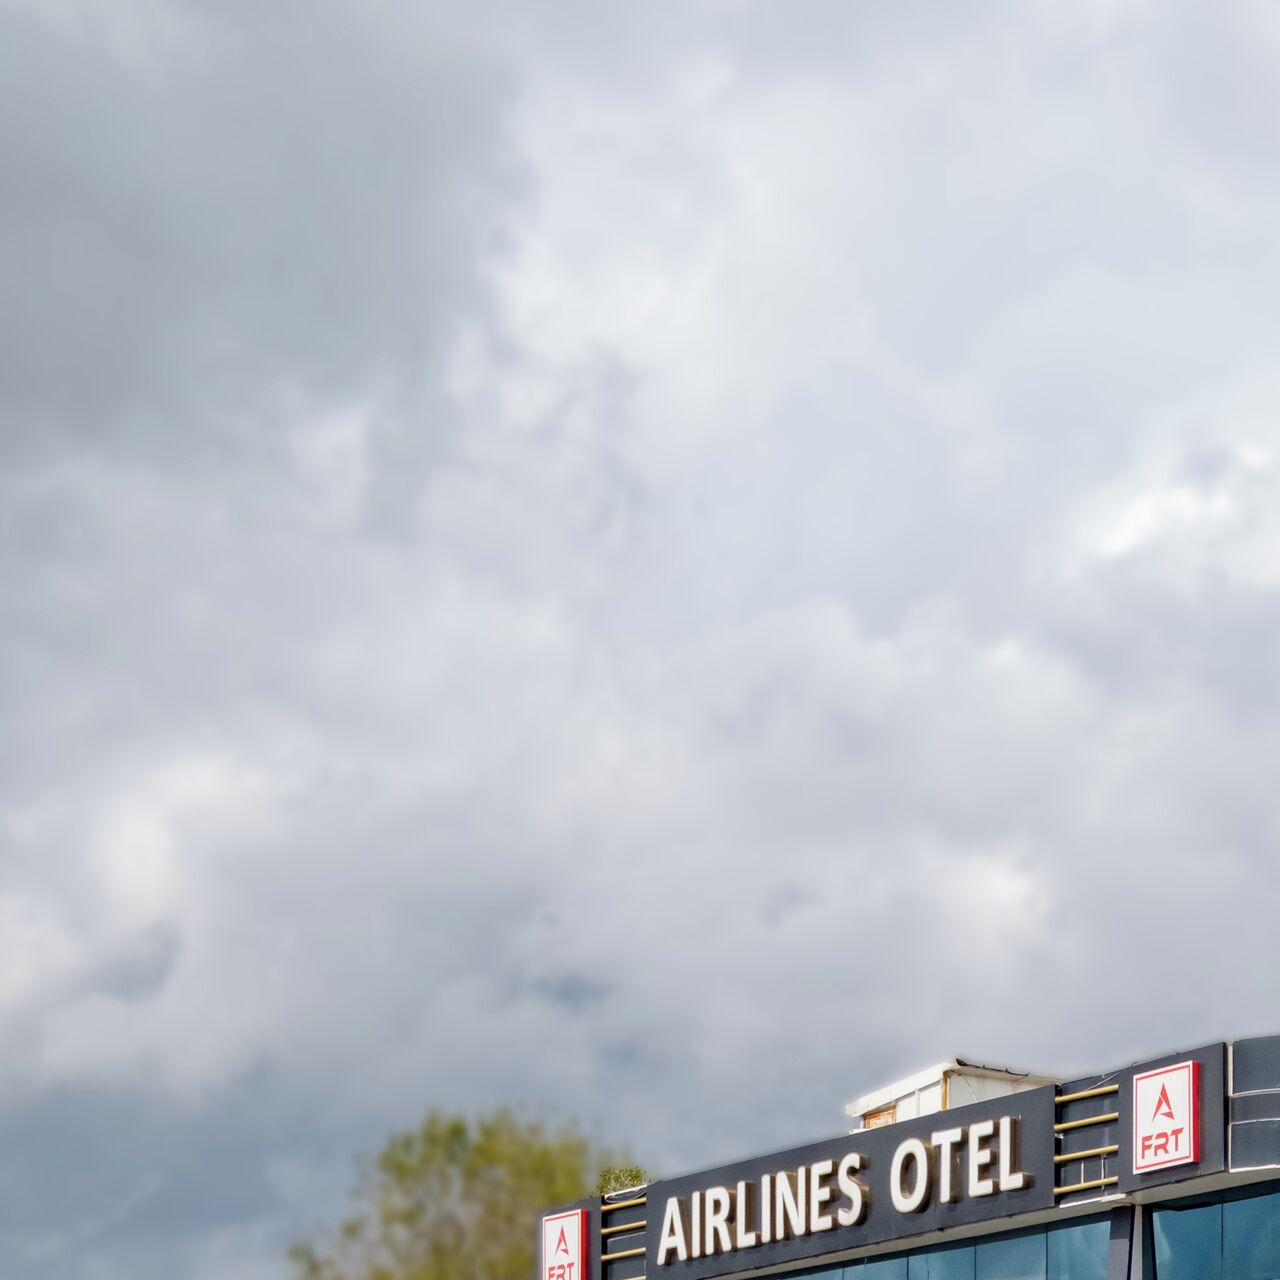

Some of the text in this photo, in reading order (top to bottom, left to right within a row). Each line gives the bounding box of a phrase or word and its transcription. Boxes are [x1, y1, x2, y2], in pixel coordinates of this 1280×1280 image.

[1141, 1127, 1186, 1159] FRT
[656, 1114, 1033, 1266] AIRLINES OTEL
